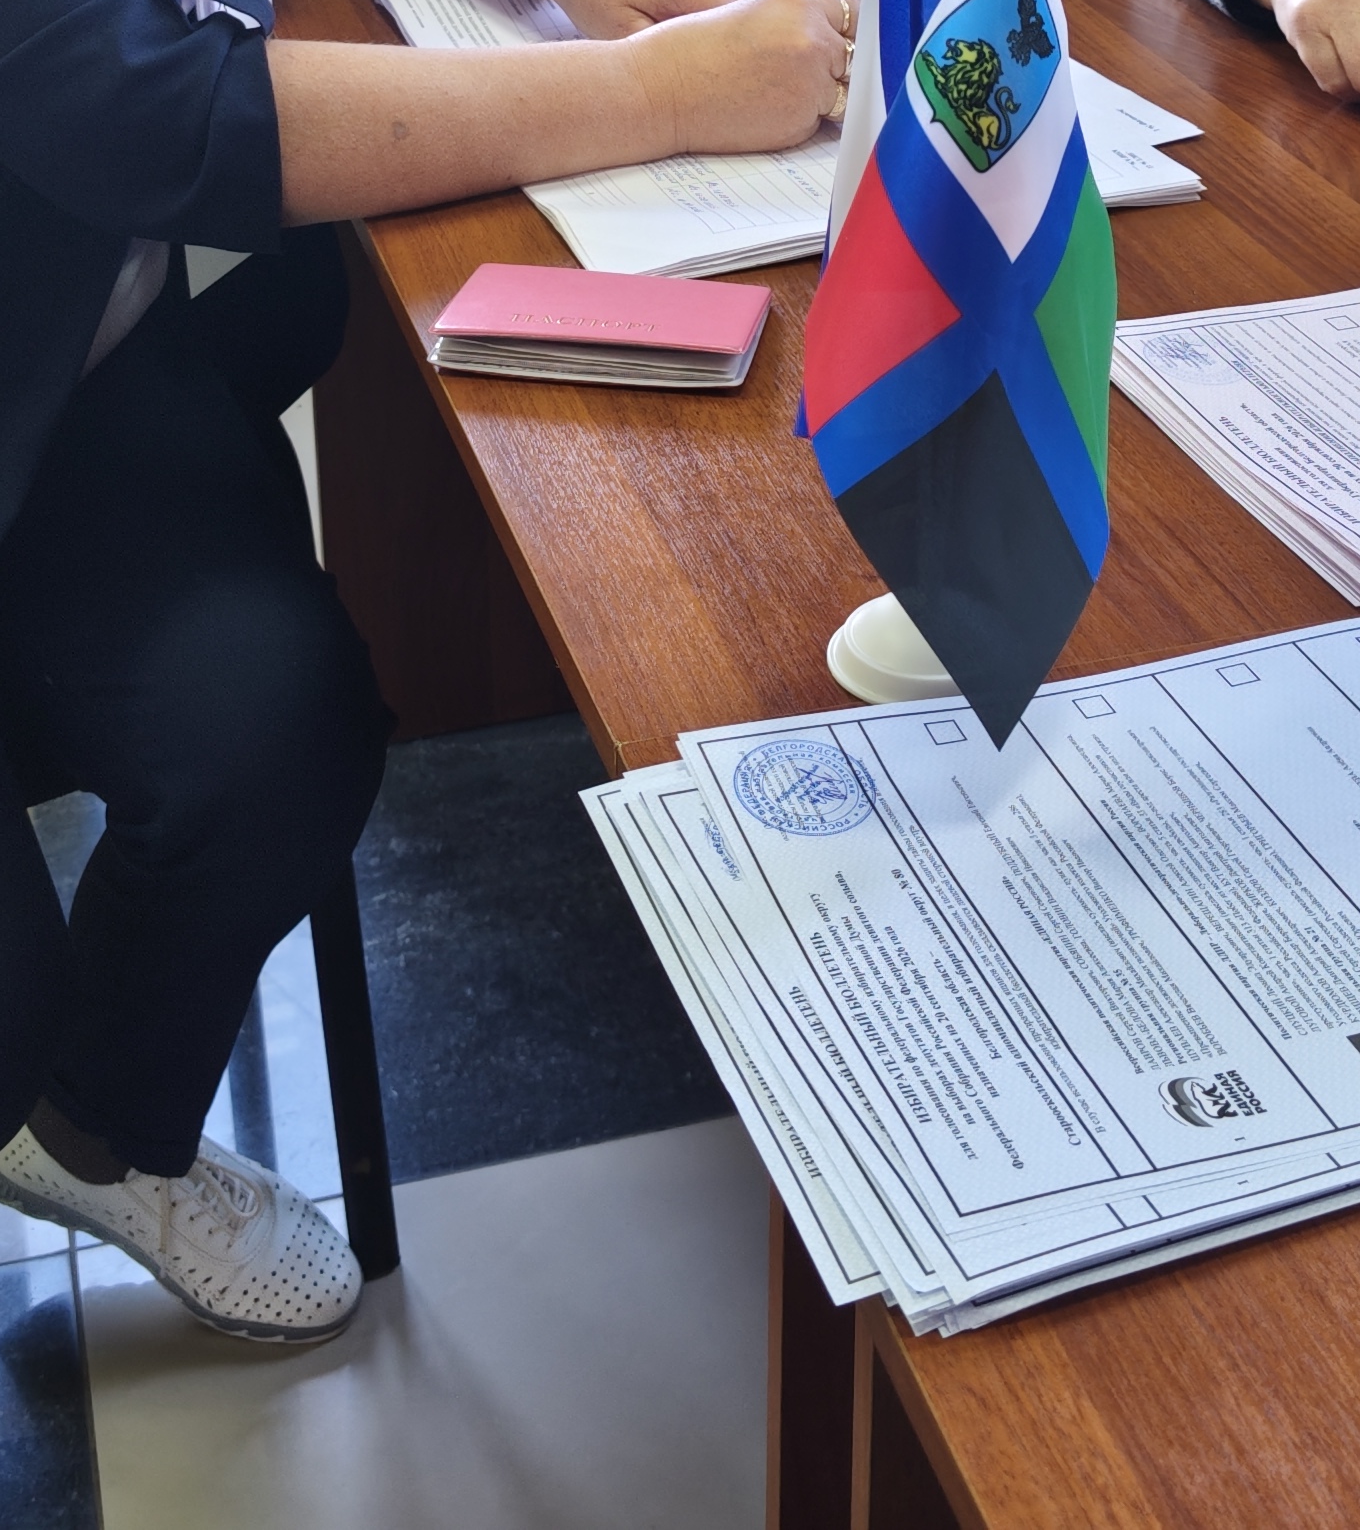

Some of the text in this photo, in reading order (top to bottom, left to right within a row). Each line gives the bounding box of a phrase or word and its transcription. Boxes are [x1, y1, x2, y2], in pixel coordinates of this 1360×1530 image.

[512, 313, 658, 332] ПАСПОРТ
[1218, 416, 1360, 524] ИЗБИРАТЕЛЬНЫЙ БЮЛЛЕТЕНЬ
[808, 892, 978, 1160] для голосования по федеральному избирательному округу
[809, 931, 932, 1123] ИЗБИРАТЕЛЬНЫЙ БЮЛЛЕТЕНЬ
[834, 870, 1024, 1169] Федерального Собрания Российской Федерации девятого созыва,
[840, 915, 975, 1124] на выборах депутатов Государственной Думы
[884, 925, 999, 1097] назначенных на 20 сентября 2026 года
[890, 868, 1081, 1145] Старооскольский одномандатный избирательный округ № 80
[933, 958, 1002, 1059] Белгородская область
[1225, 1069, 1267, 1114] РОССИЯ
[1213, 1072, 1254, 1116] ЕДИНАЯ
